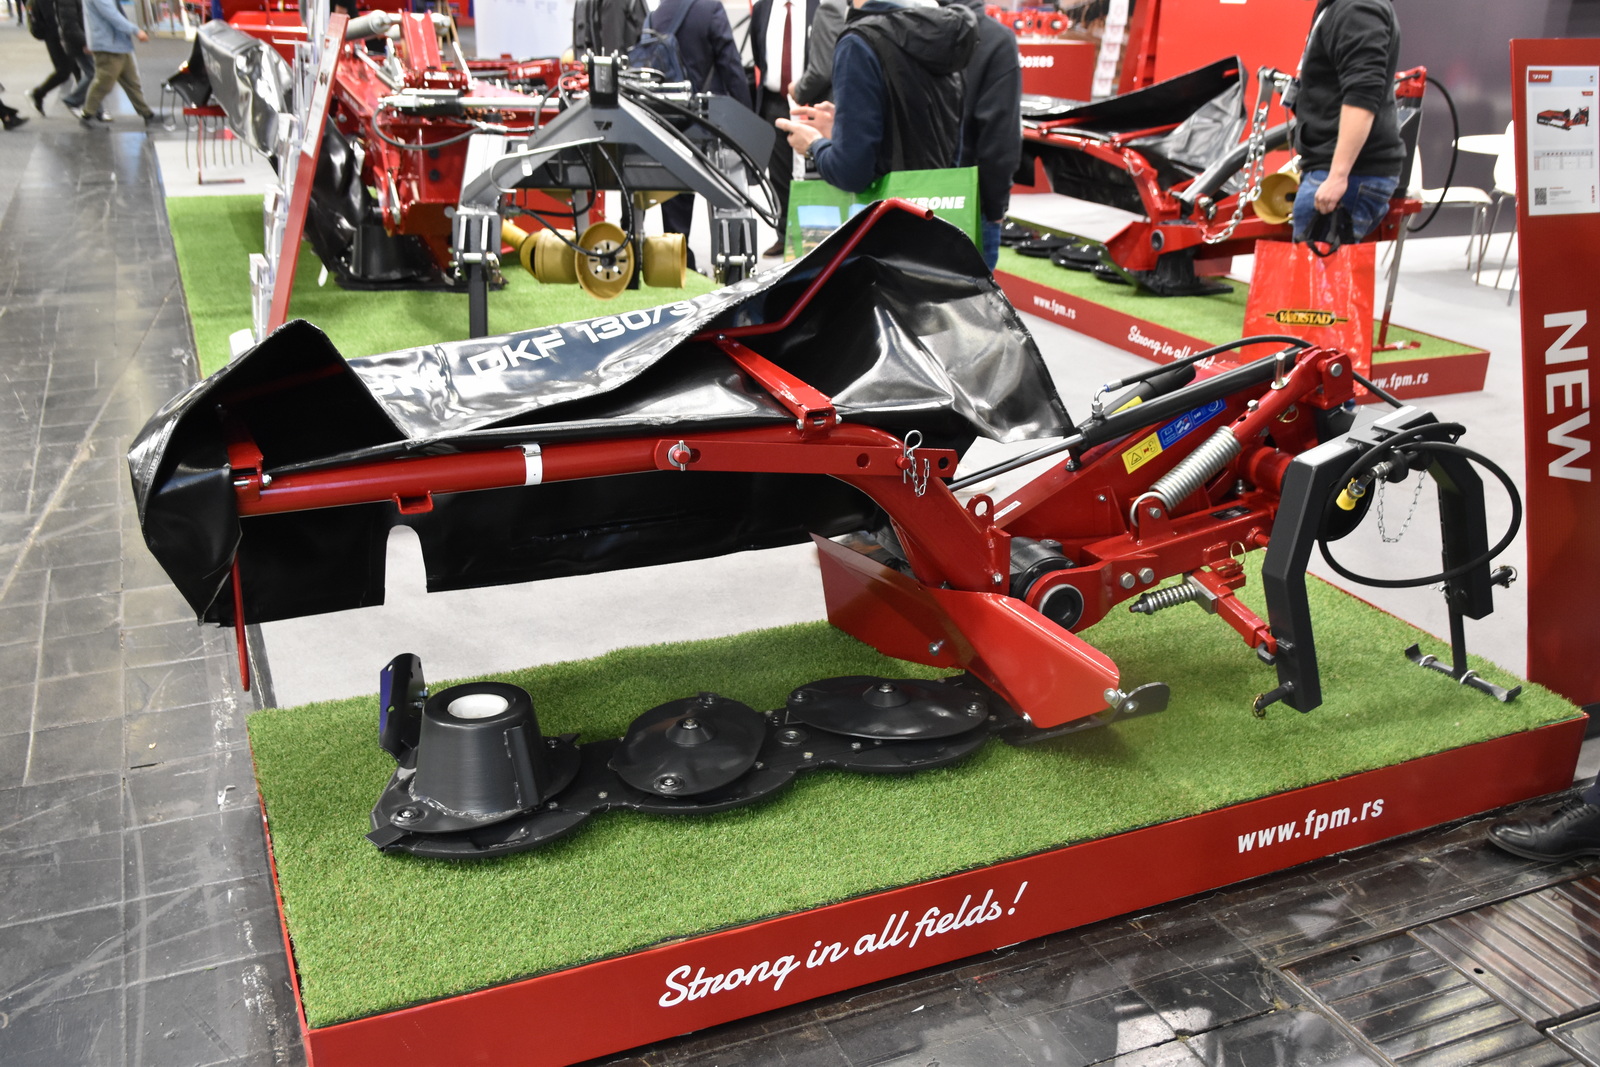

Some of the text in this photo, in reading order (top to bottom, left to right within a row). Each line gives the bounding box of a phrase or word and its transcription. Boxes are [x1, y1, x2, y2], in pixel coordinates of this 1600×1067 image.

[1033, 295, 1076, 320] www.fpm.rs
[467, 329, 566, 378] DKF
[1128, 325, 1191, 359] Strong in all
[1371, 372, 1429, 390] ww.fpm.rs
[1544, 310, 1592, 482] NEW
[1237, 798, 1384, 853] www.fpm.rs
[658, 954, 802, 1007] Strong
[805, 940, 849, 968] in
[853, 911, 908, 956] all
